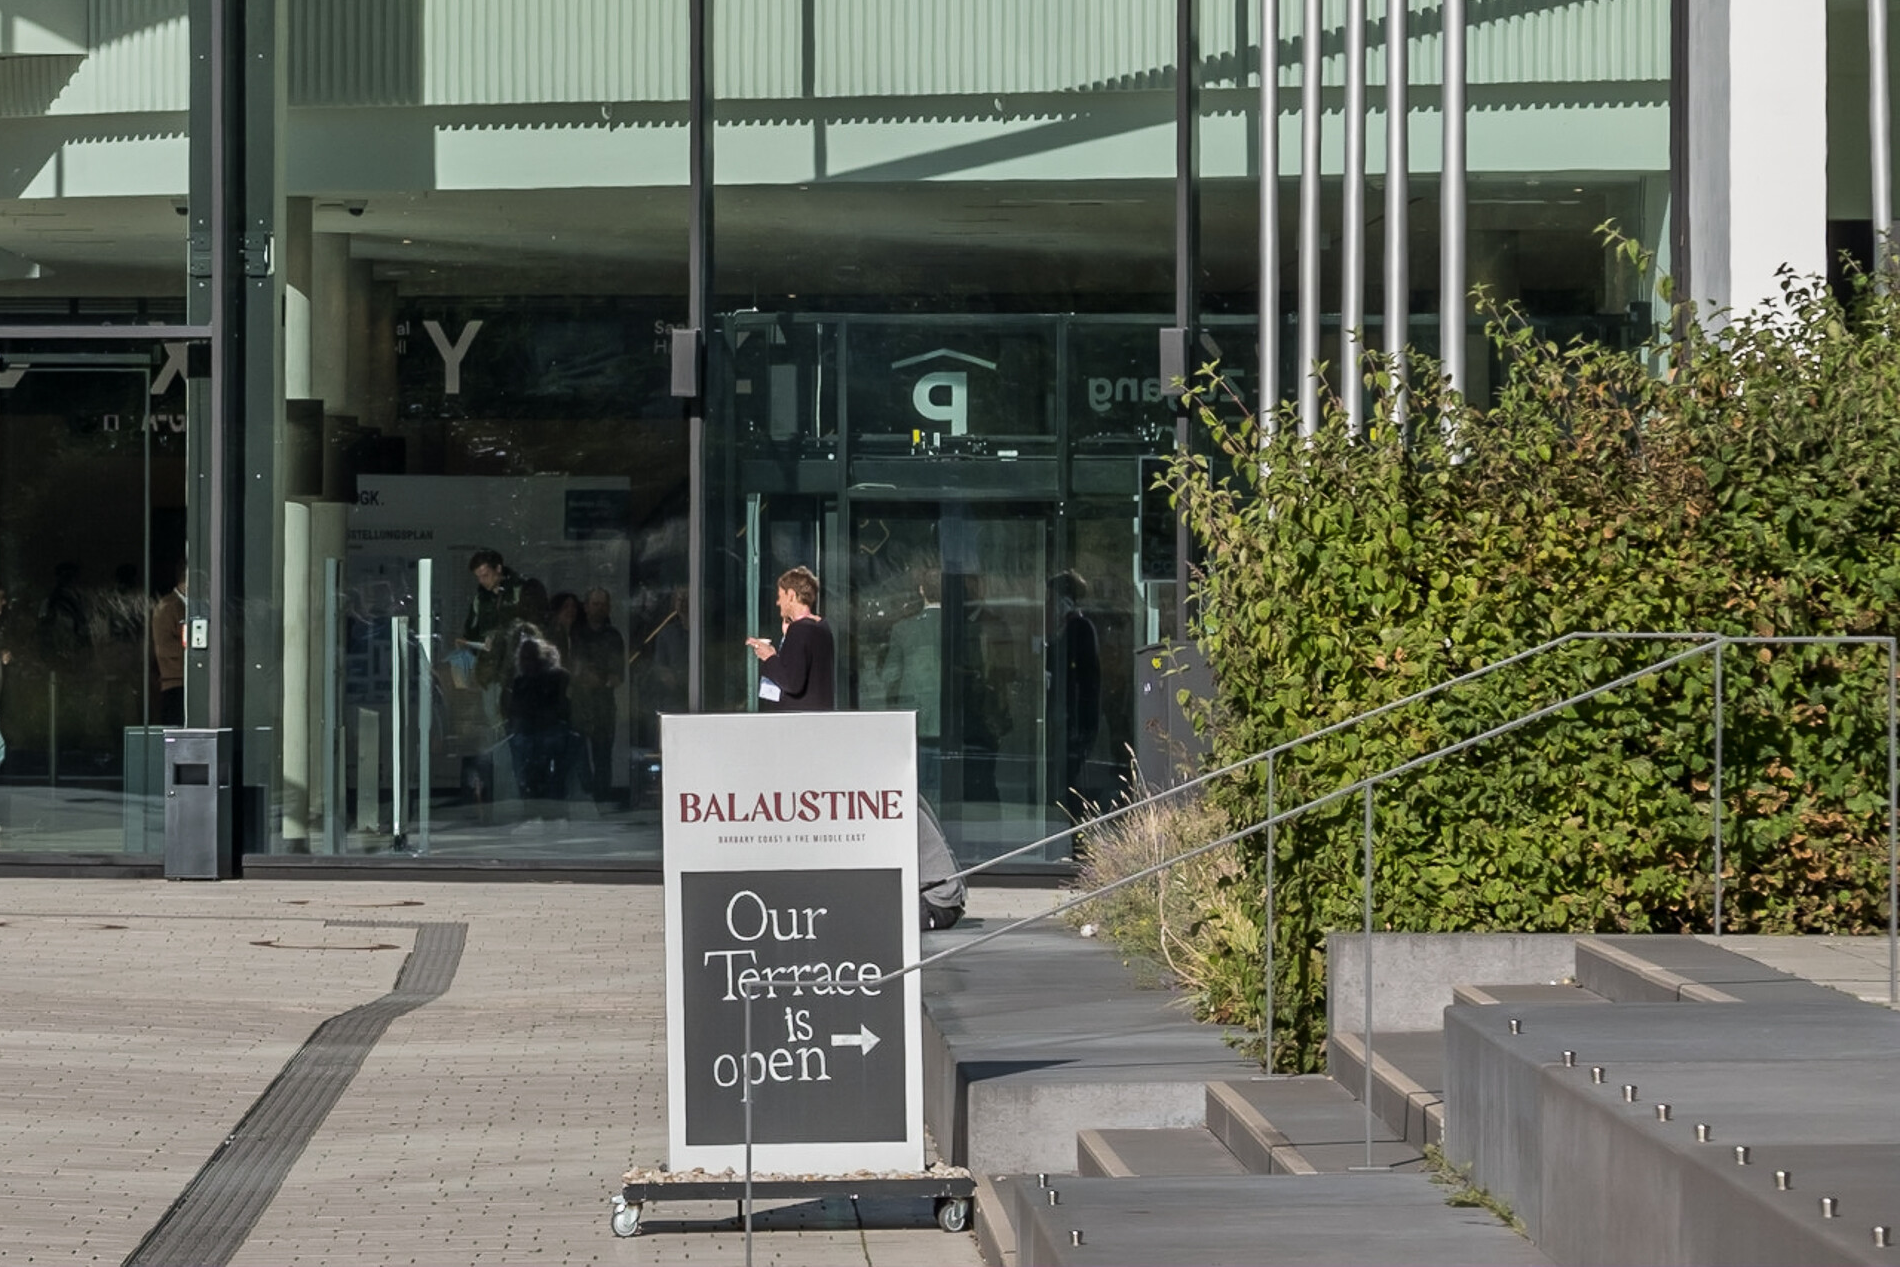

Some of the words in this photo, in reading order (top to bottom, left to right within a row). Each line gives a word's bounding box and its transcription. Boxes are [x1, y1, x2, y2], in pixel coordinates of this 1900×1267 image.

[422, 319, 485, 395] Y
[357, 489, 386, 507] GK.
[679, 789, 904, 823] BALAUSTINE
[718, 835, 755, 844] BARBARY
[757, 835, 783, 844] COAST
[794, 834, 809, 843] THE
[813, 834, 842, 843] MIDDLE
[845, 833, 866, 842] EAST
[726, 889, 828, 942] Our
[704, 949, 883, 1002] Terrace
[784, 1005, 814, 1043] is
[713, 1046, 832, 1104] open
